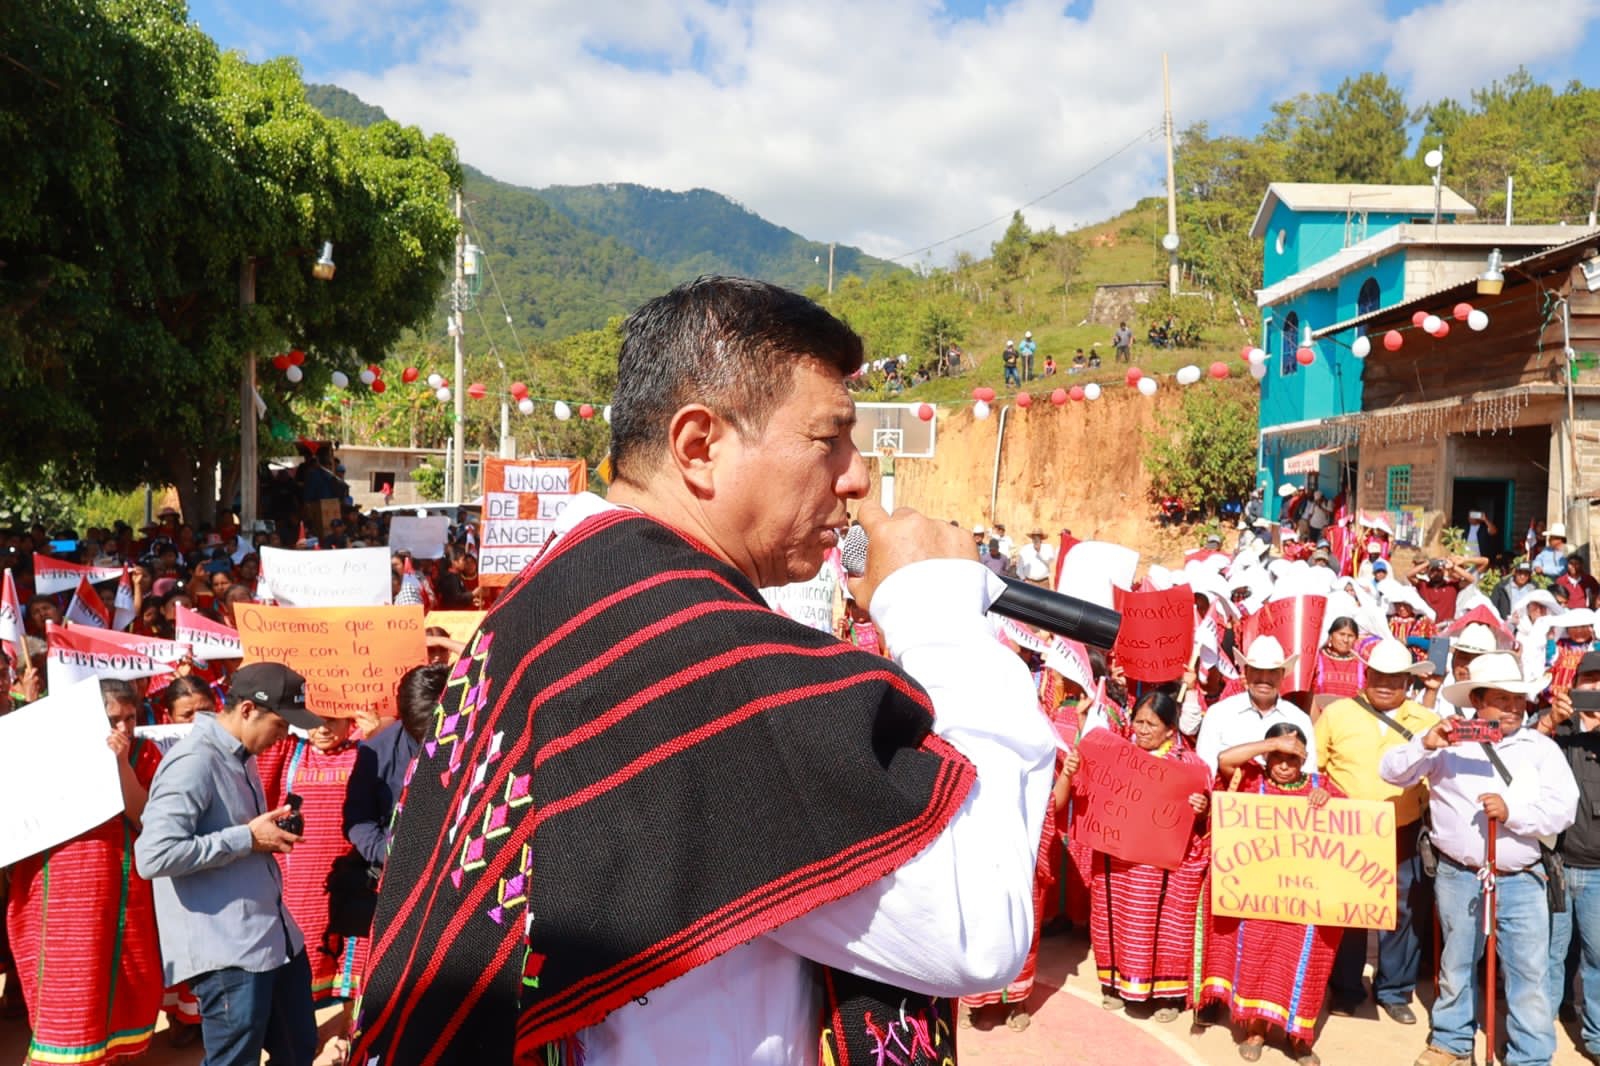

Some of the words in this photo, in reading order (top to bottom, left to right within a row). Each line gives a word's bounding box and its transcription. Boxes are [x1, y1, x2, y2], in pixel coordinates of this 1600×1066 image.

[489, 499, 516, 517] DE
[542, 501, 567, 518] LO
[243, 609, 329, 635] Queremos
[345, 617, 375, 638] que
[387, 617, 419, 632] nos
[58, 649, 156, 673] UBISORT
[249, 646, 299, 663] apoye
[309, 646, 339, 657] con
[352, 640, 370, 656] la
[362, 661, 384, 678] de
[342, 681, 384, 699] para
[1103, 799, 1129, 819] en
[1217, 796, 1394, 839] BIENVENIDO
[1213, 832, 1395, 899] GOBERNADOR
[1278, 873, 1320, 890] ING.
[1218, 874, 1323, 919] SALOMON
[1336, 901, 1394, 928] JARA
